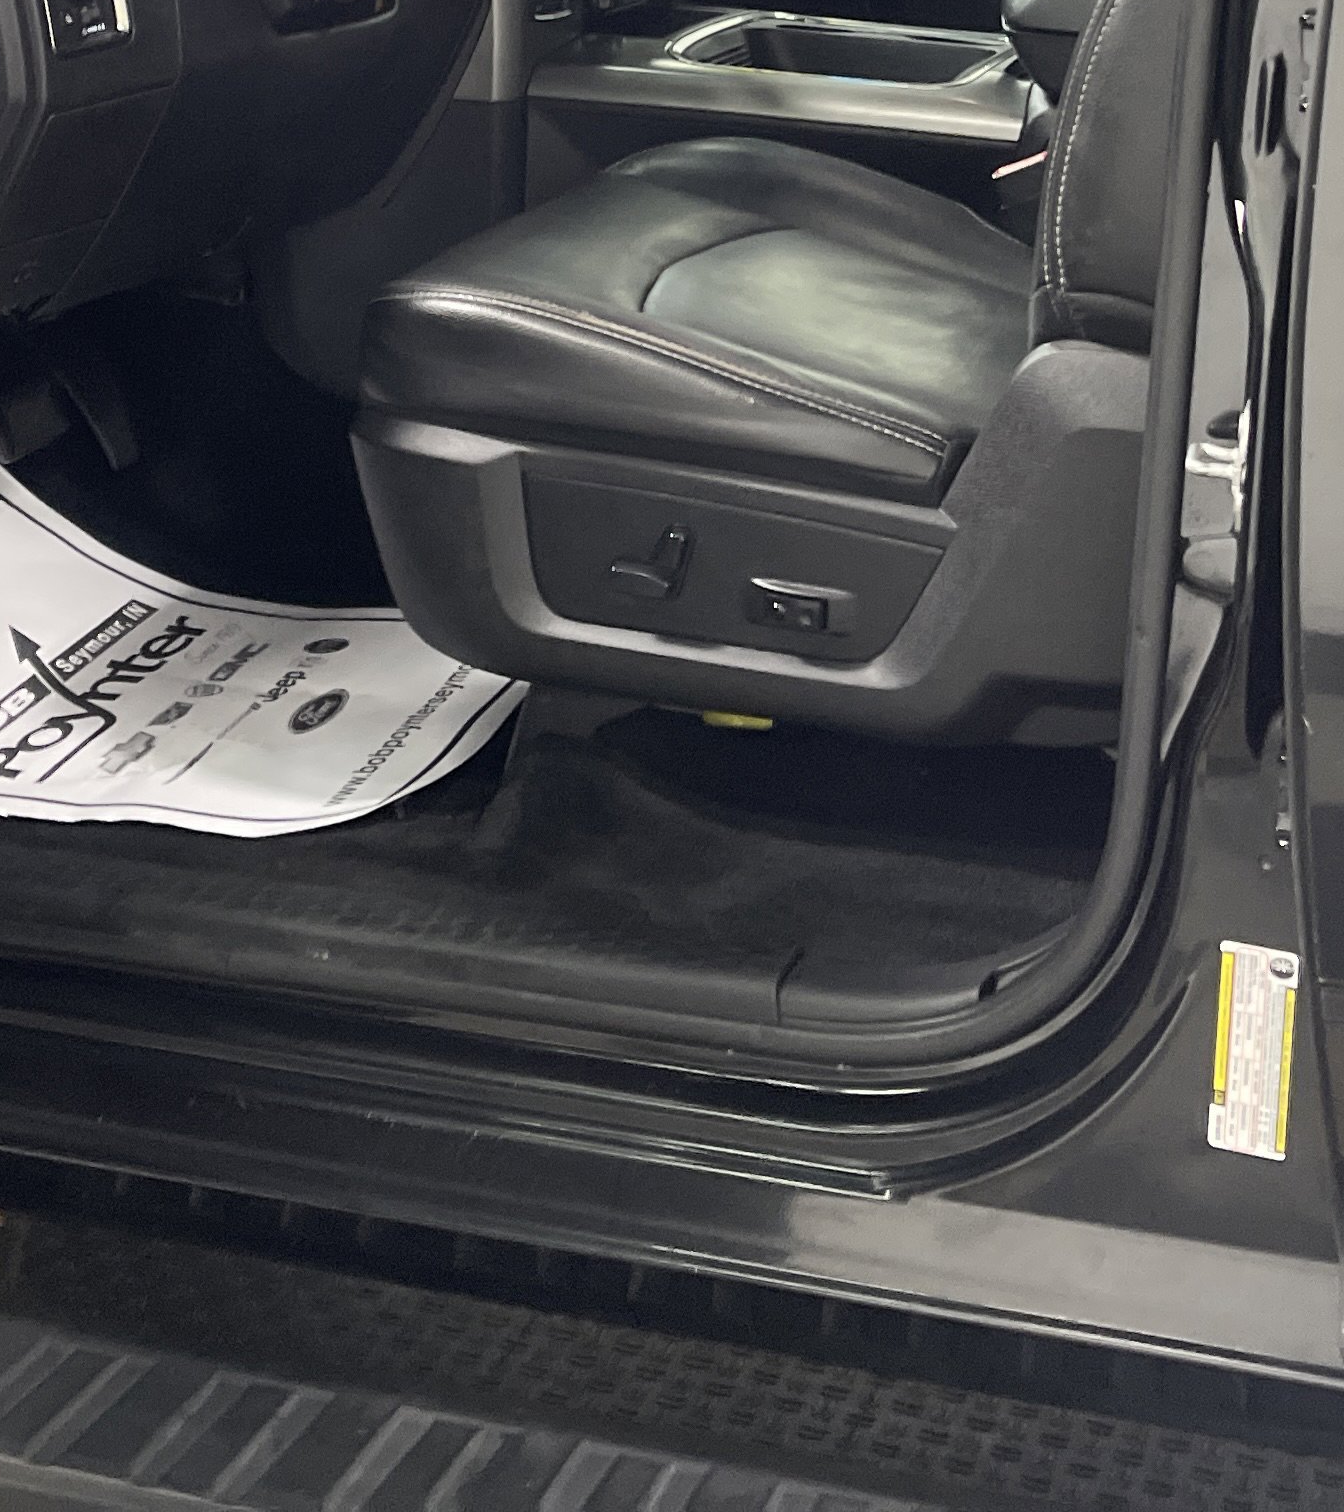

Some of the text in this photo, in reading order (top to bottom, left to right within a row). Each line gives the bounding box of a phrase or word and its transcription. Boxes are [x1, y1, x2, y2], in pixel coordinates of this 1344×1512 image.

[54, 618, 133, 674] Seymour,
[120, 601, 150, 628] IN
[257, 670, 306, 702] Jeep
